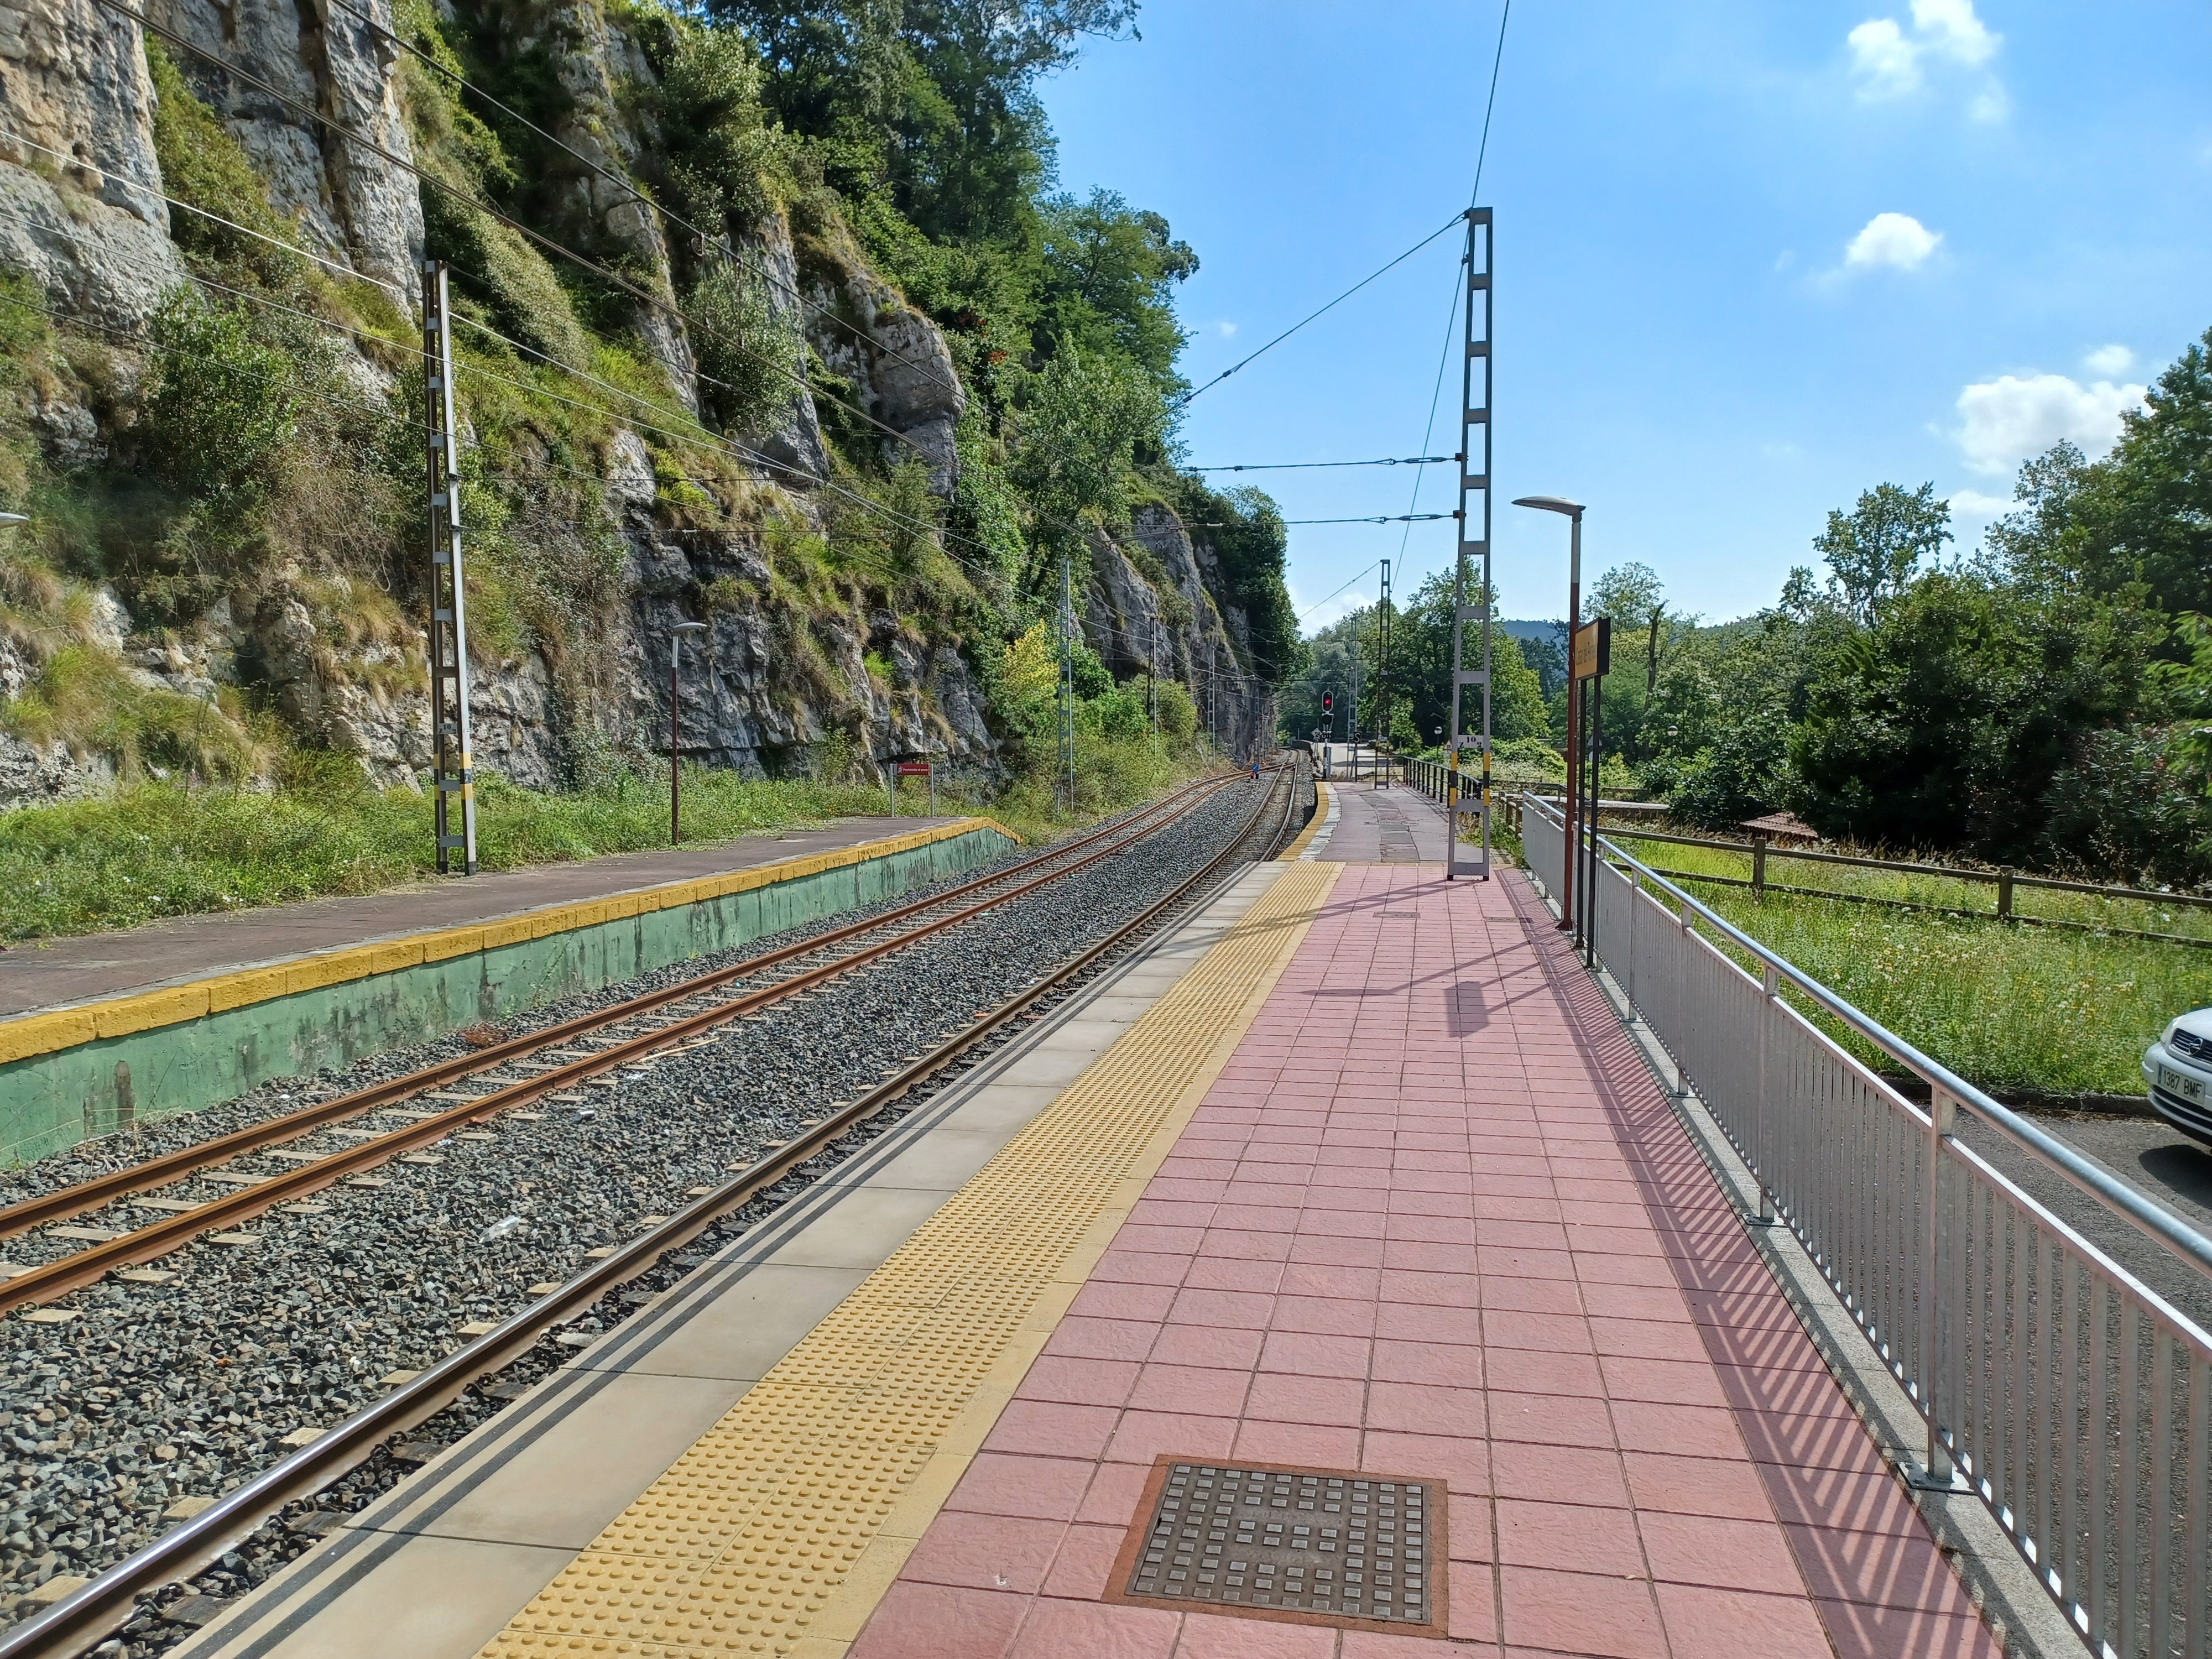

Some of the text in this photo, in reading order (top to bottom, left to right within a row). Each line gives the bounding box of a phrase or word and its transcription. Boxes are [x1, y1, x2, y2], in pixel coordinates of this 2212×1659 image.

[1354, 733, 1360, 743] S
[2163, 1070, 2202, 1099] 1387 BMF
